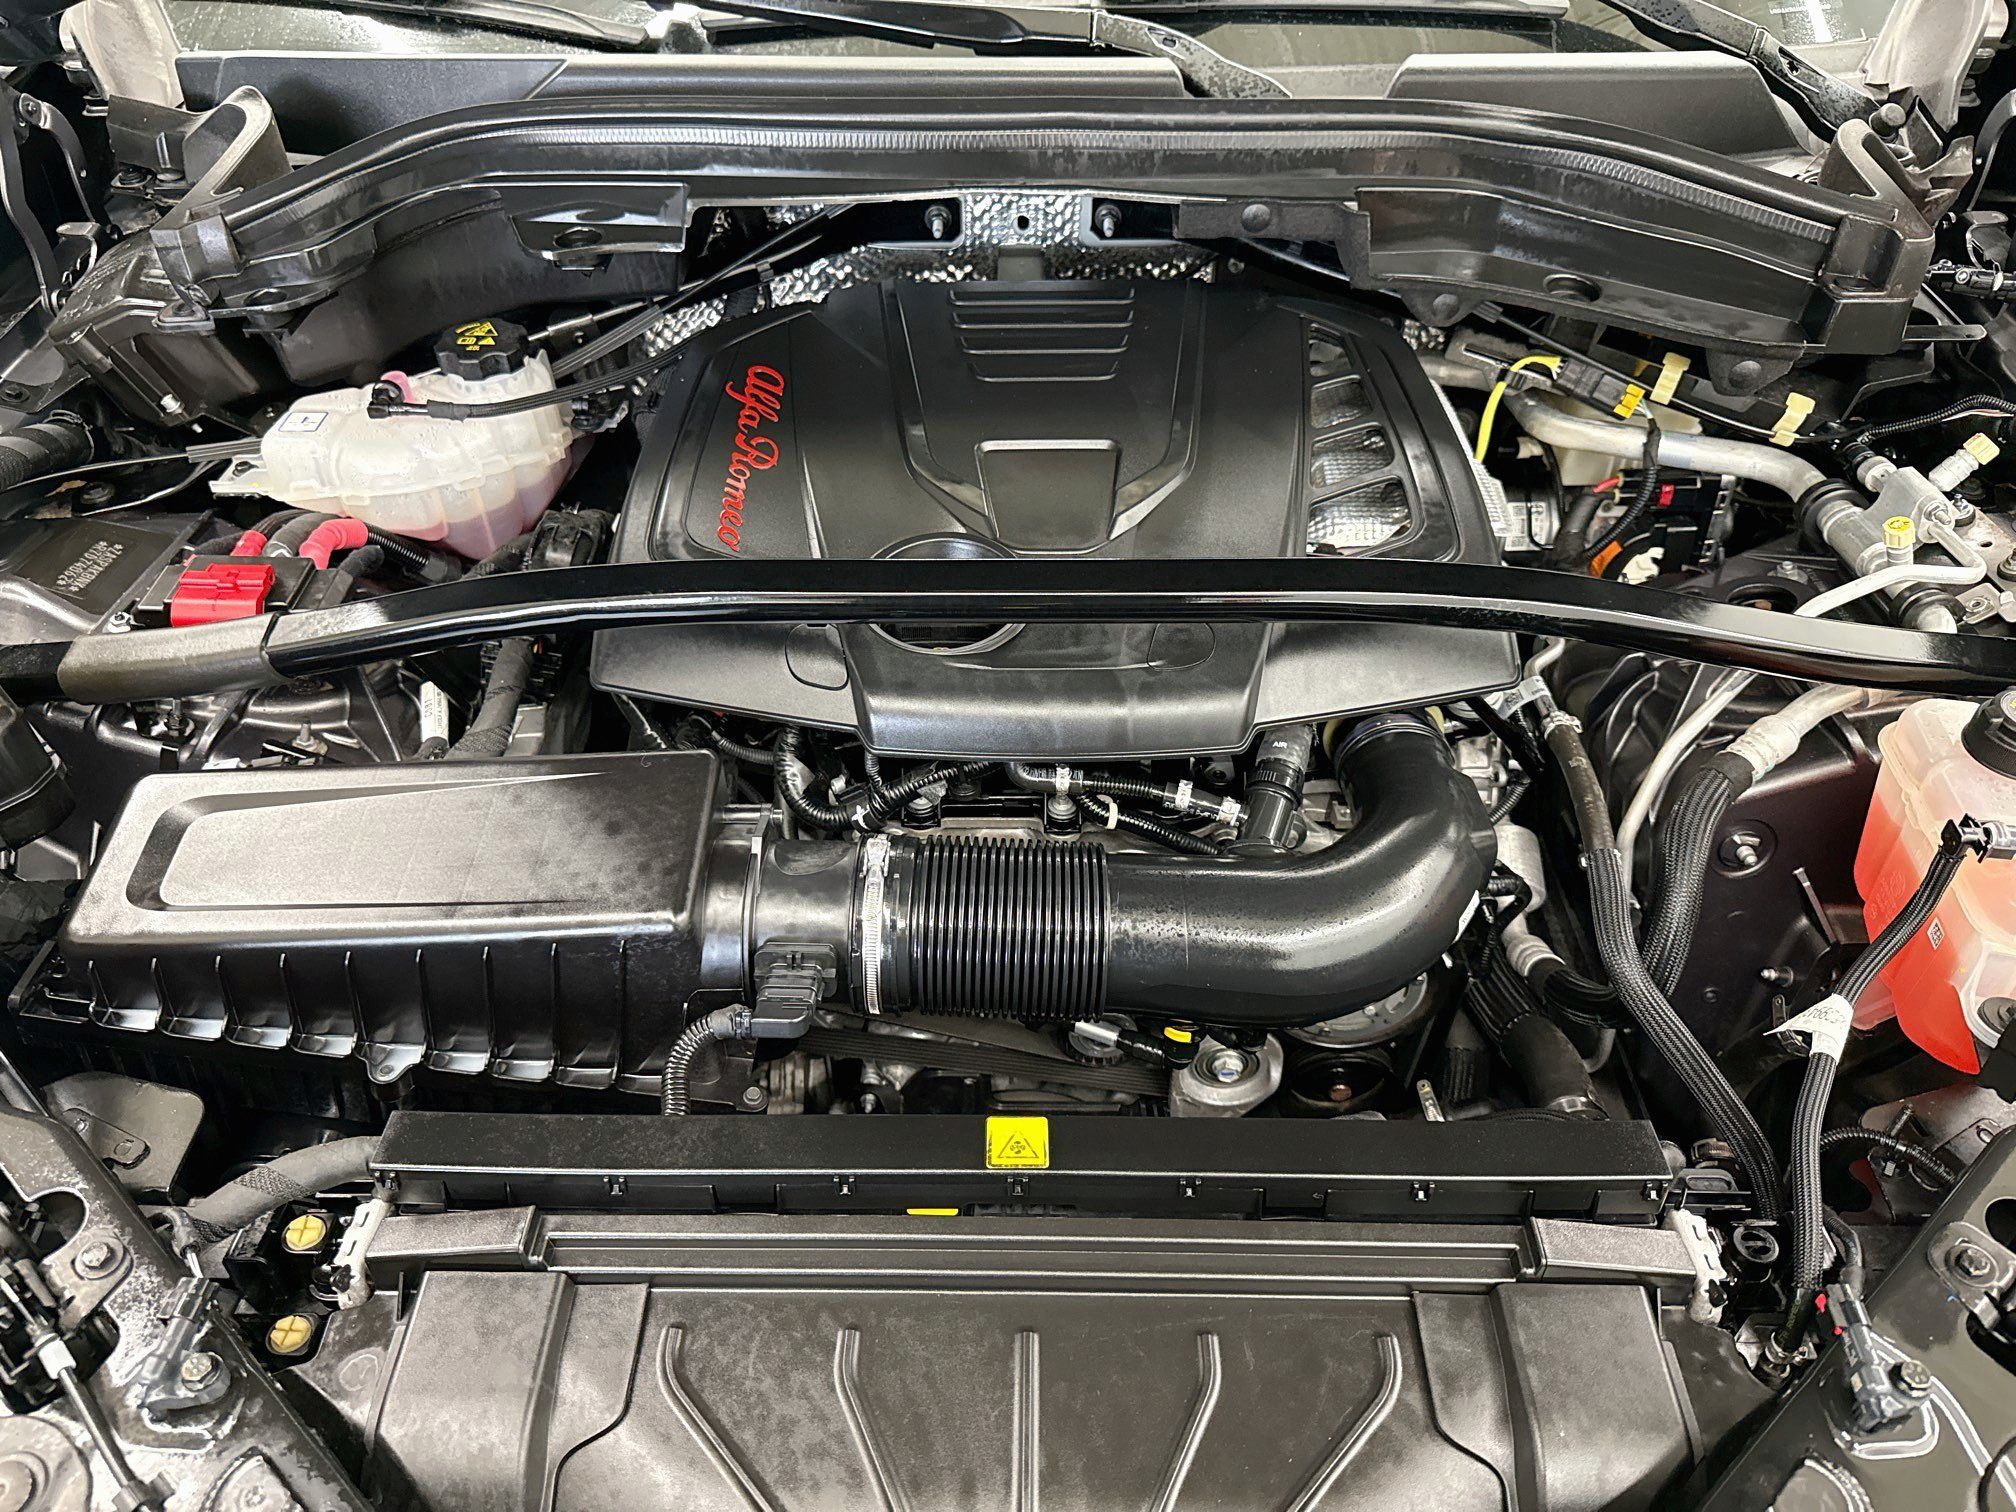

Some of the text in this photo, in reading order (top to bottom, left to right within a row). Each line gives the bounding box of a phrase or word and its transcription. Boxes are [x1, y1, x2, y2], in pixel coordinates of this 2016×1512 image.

[717, 365, 785, 551] Alfa Romeo
[1272, 740, 1288, 749] AIR
